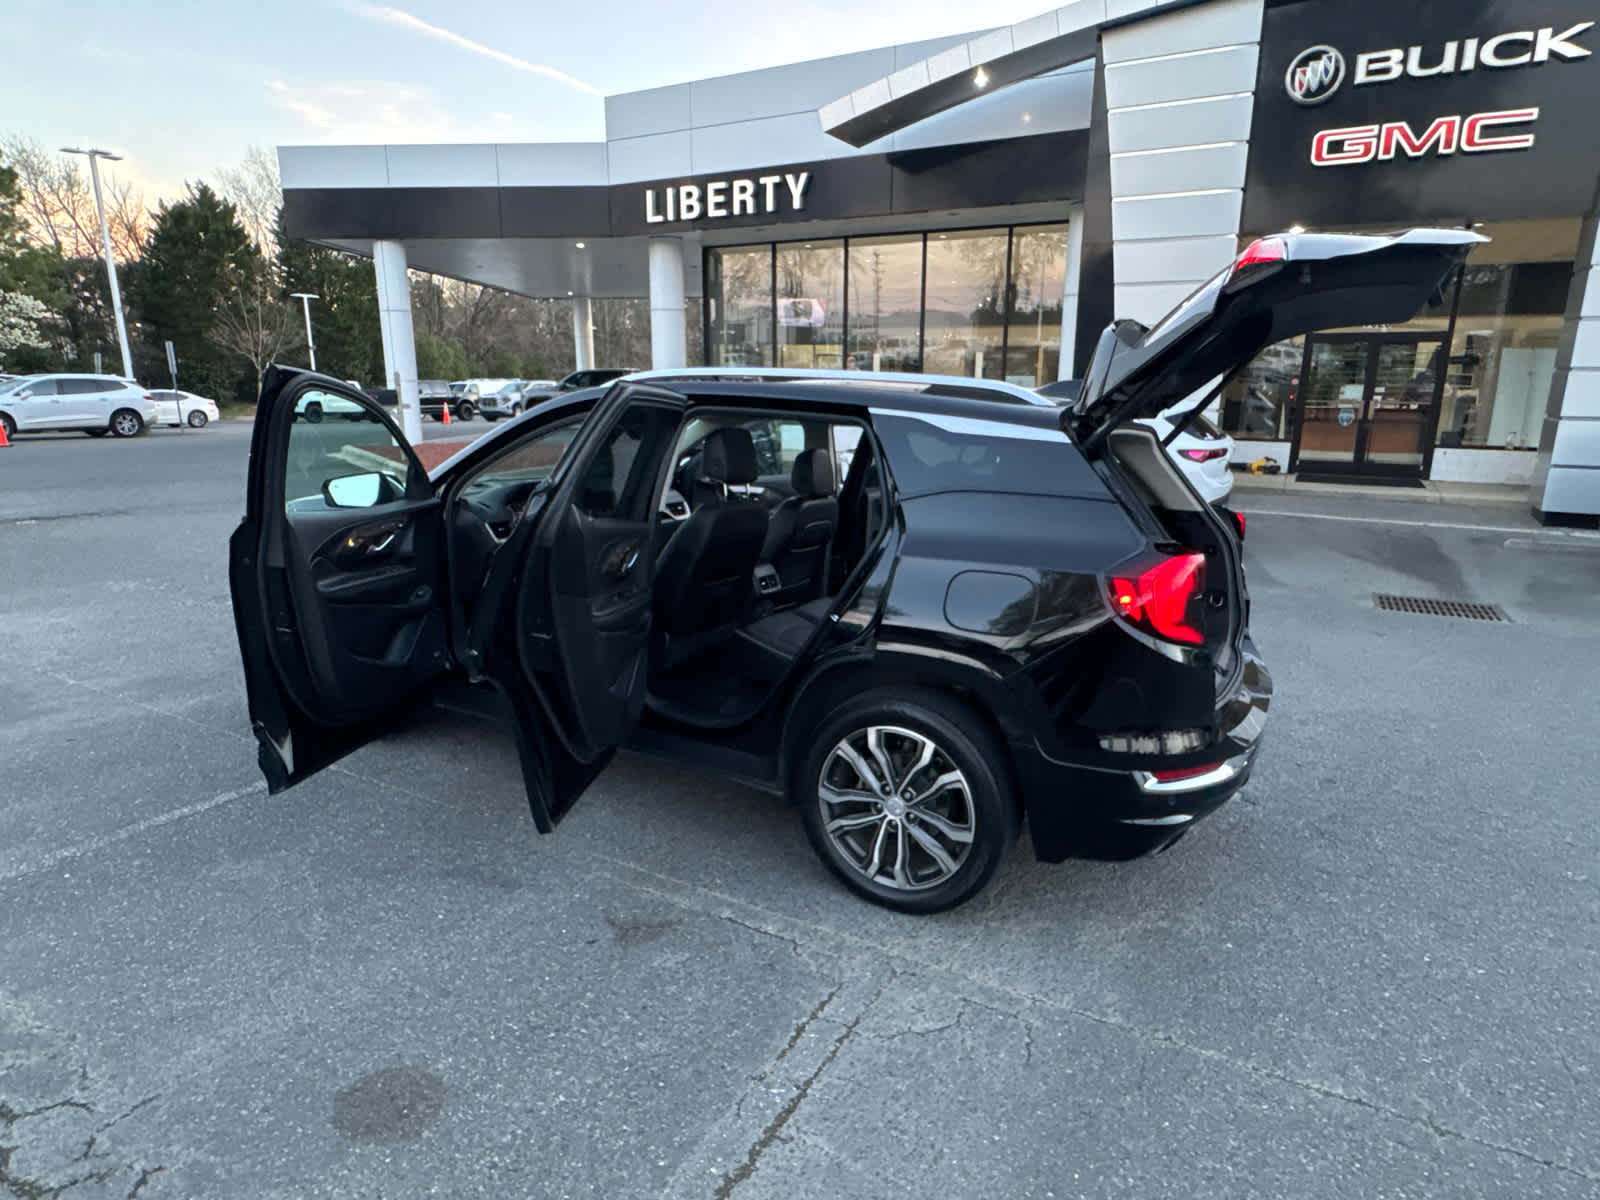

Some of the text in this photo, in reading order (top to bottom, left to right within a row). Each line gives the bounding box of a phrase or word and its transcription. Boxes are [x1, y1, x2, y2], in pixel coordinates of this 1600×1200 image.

[1353, 21, 1595, 85] BUICK
[1310, 107, 1539, 167] GMC
[644, 171, 809, 223] LIBERTY
